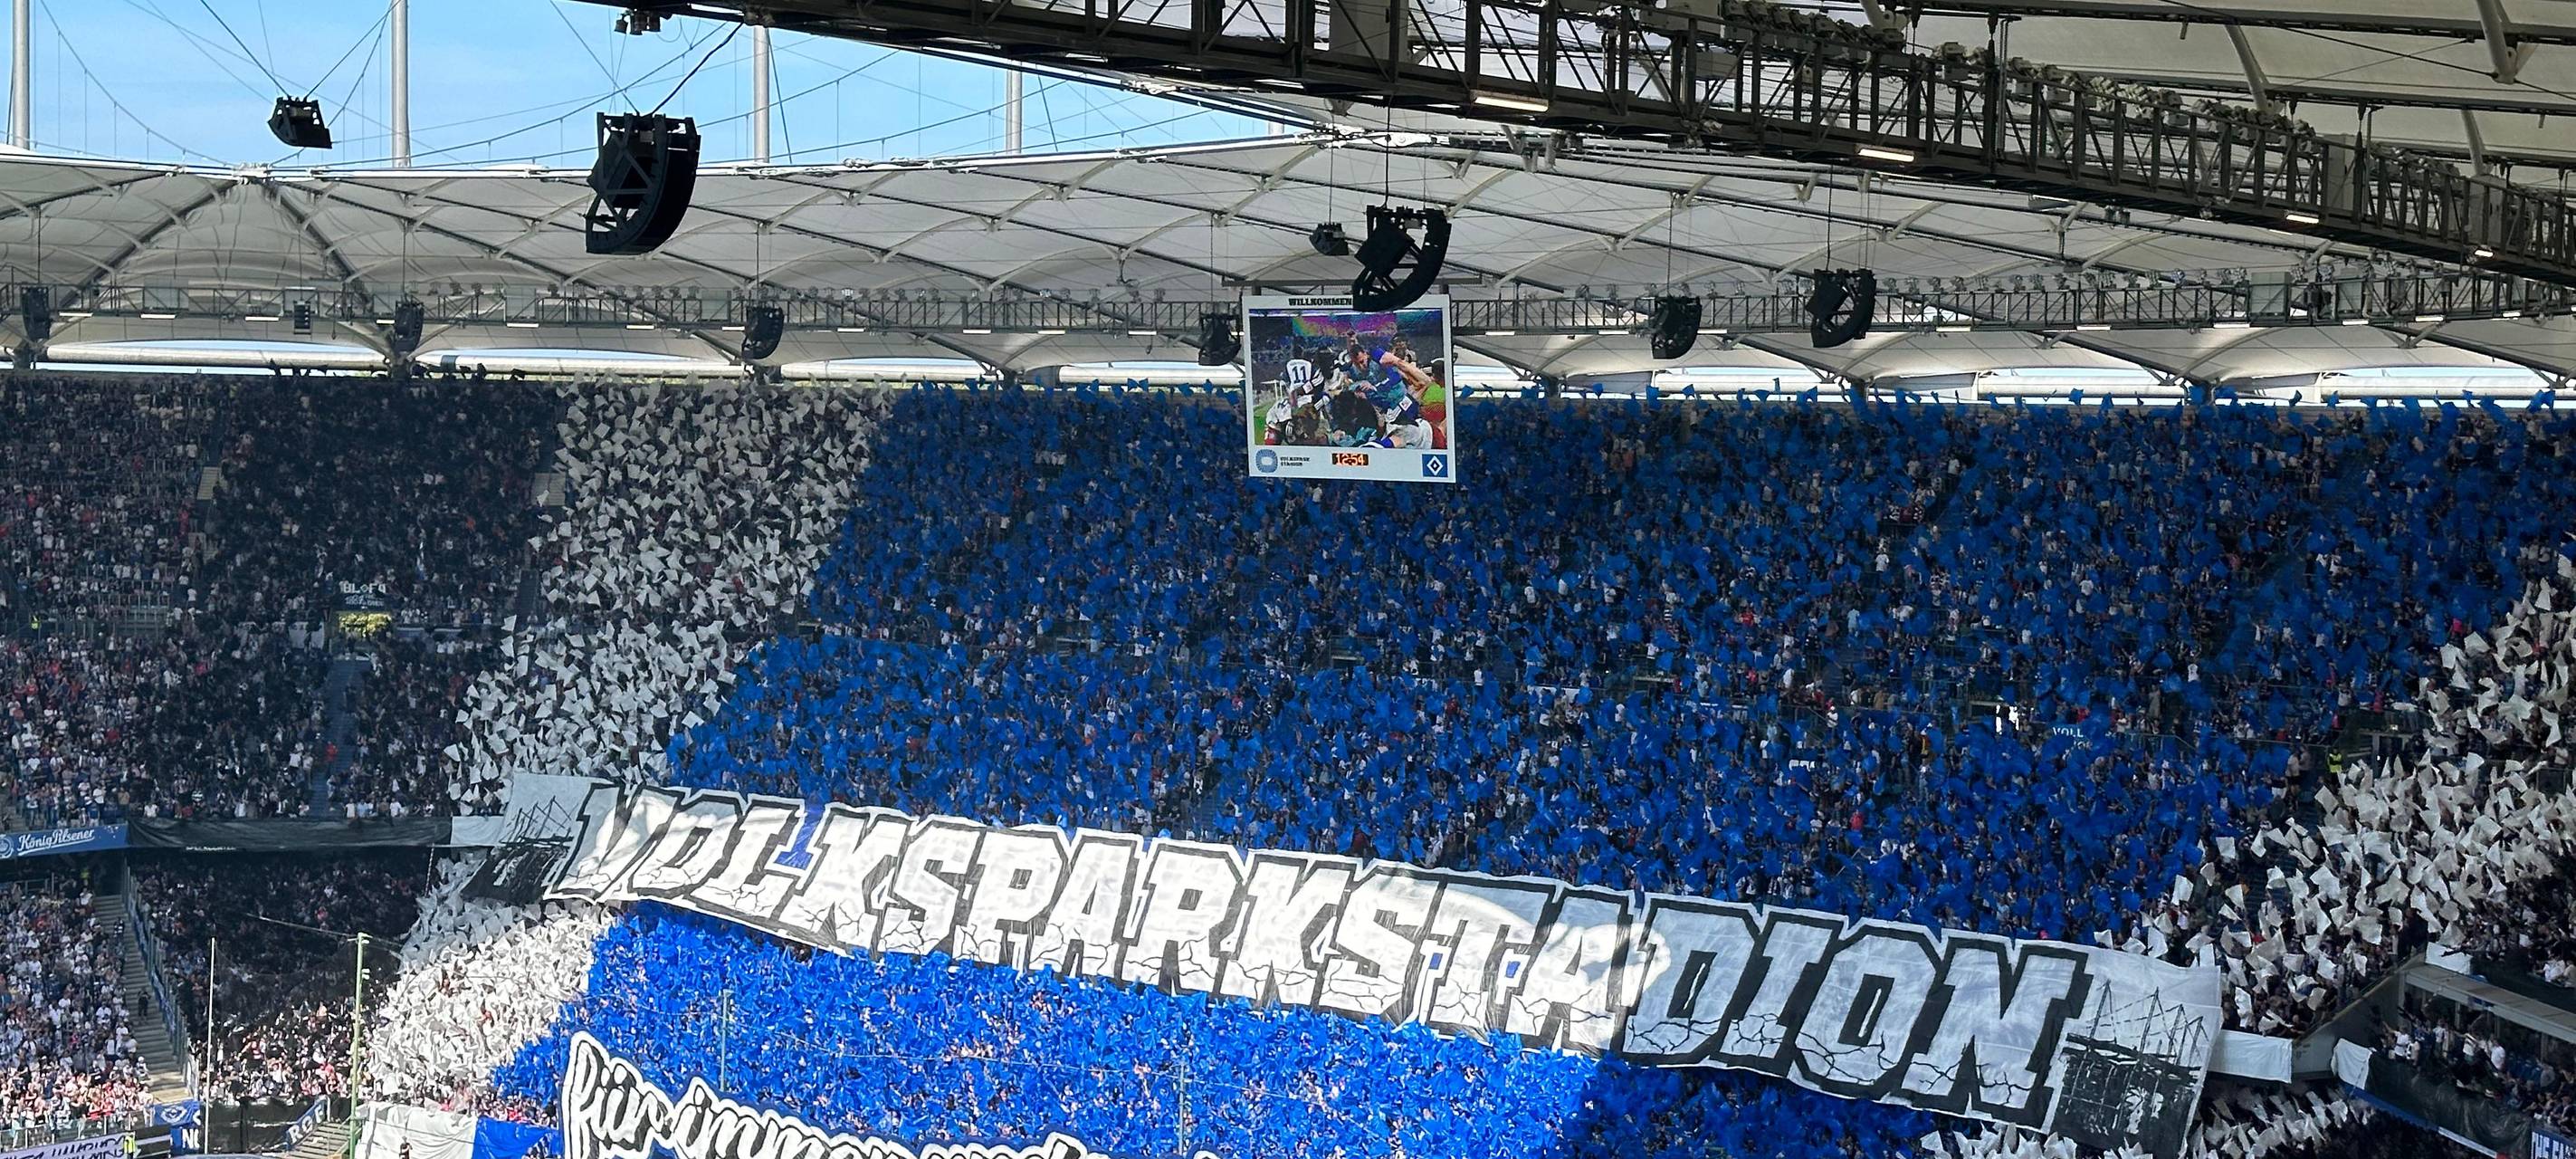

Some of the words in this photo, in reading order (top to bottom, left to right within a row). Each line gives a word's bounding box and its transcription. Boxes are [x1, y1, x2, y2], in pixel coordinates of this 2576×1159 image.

[1288, 298, 1352, 306] WILLKOMMEN
[1293, 366, 1306, 384] 11
[549, 783, 2087, 1132] VOLKSPARKSTADION
[672, 1083, 917, 1159] imm
